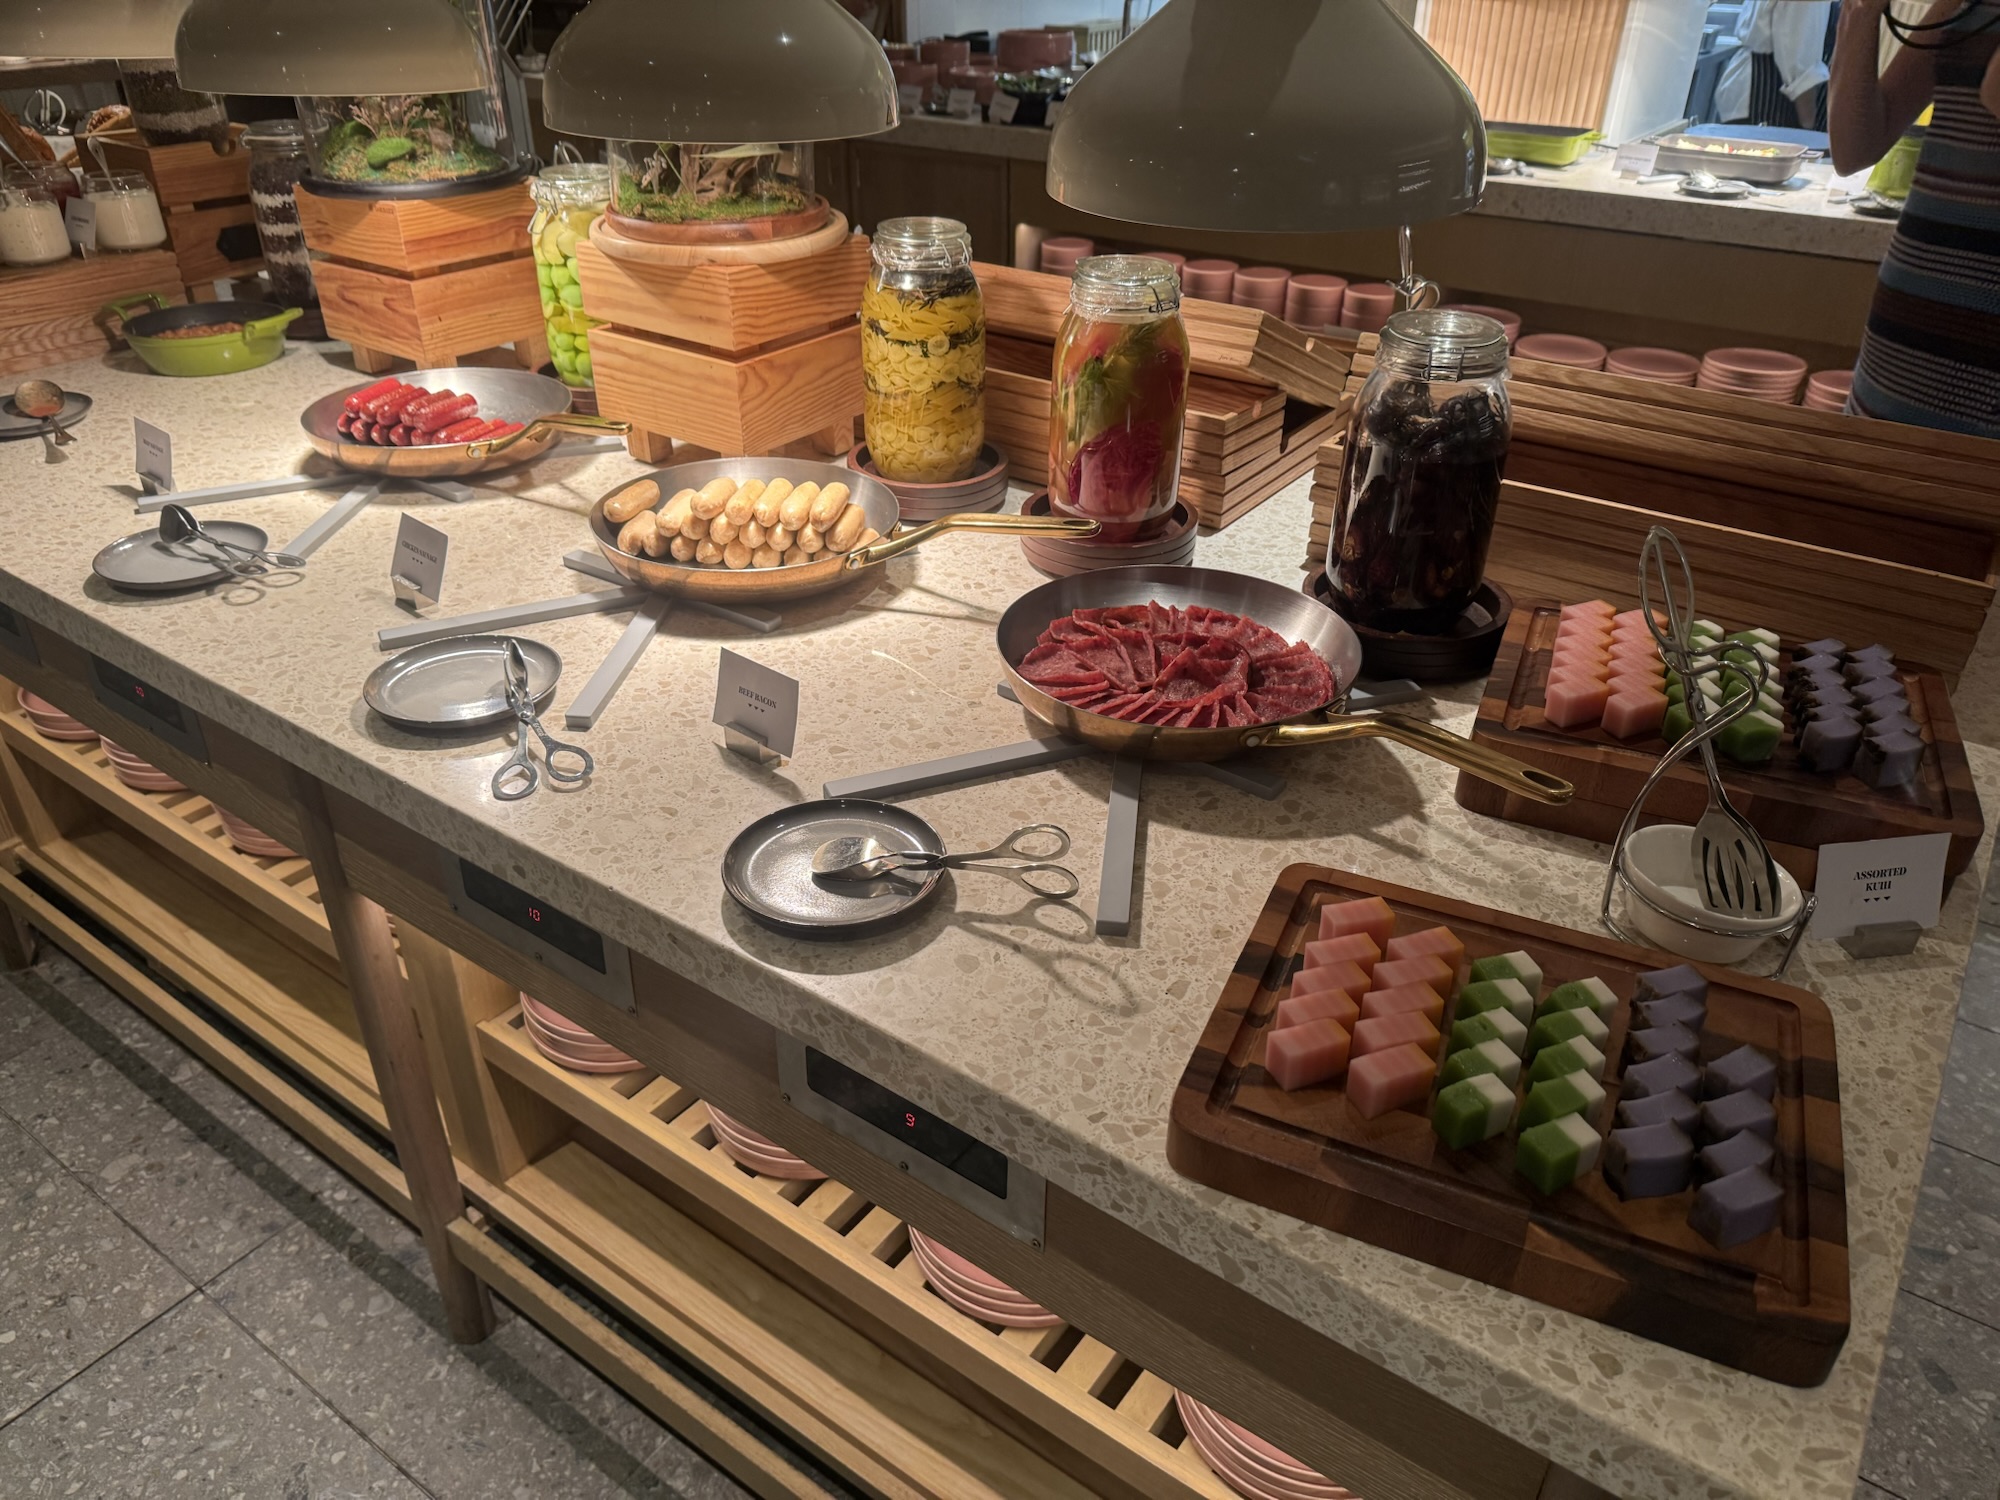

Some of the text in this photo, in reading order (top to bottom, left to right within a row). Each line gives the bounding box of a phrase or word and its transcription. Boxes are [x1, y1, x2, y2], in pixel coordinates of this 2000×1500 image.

[738, 685, 777, 709] BEEF BACON
[1853, 866, 1907, 880] ASSORTED
[528, 907, 541, 922] 10
[905, 1112, 915, 1127] 9
